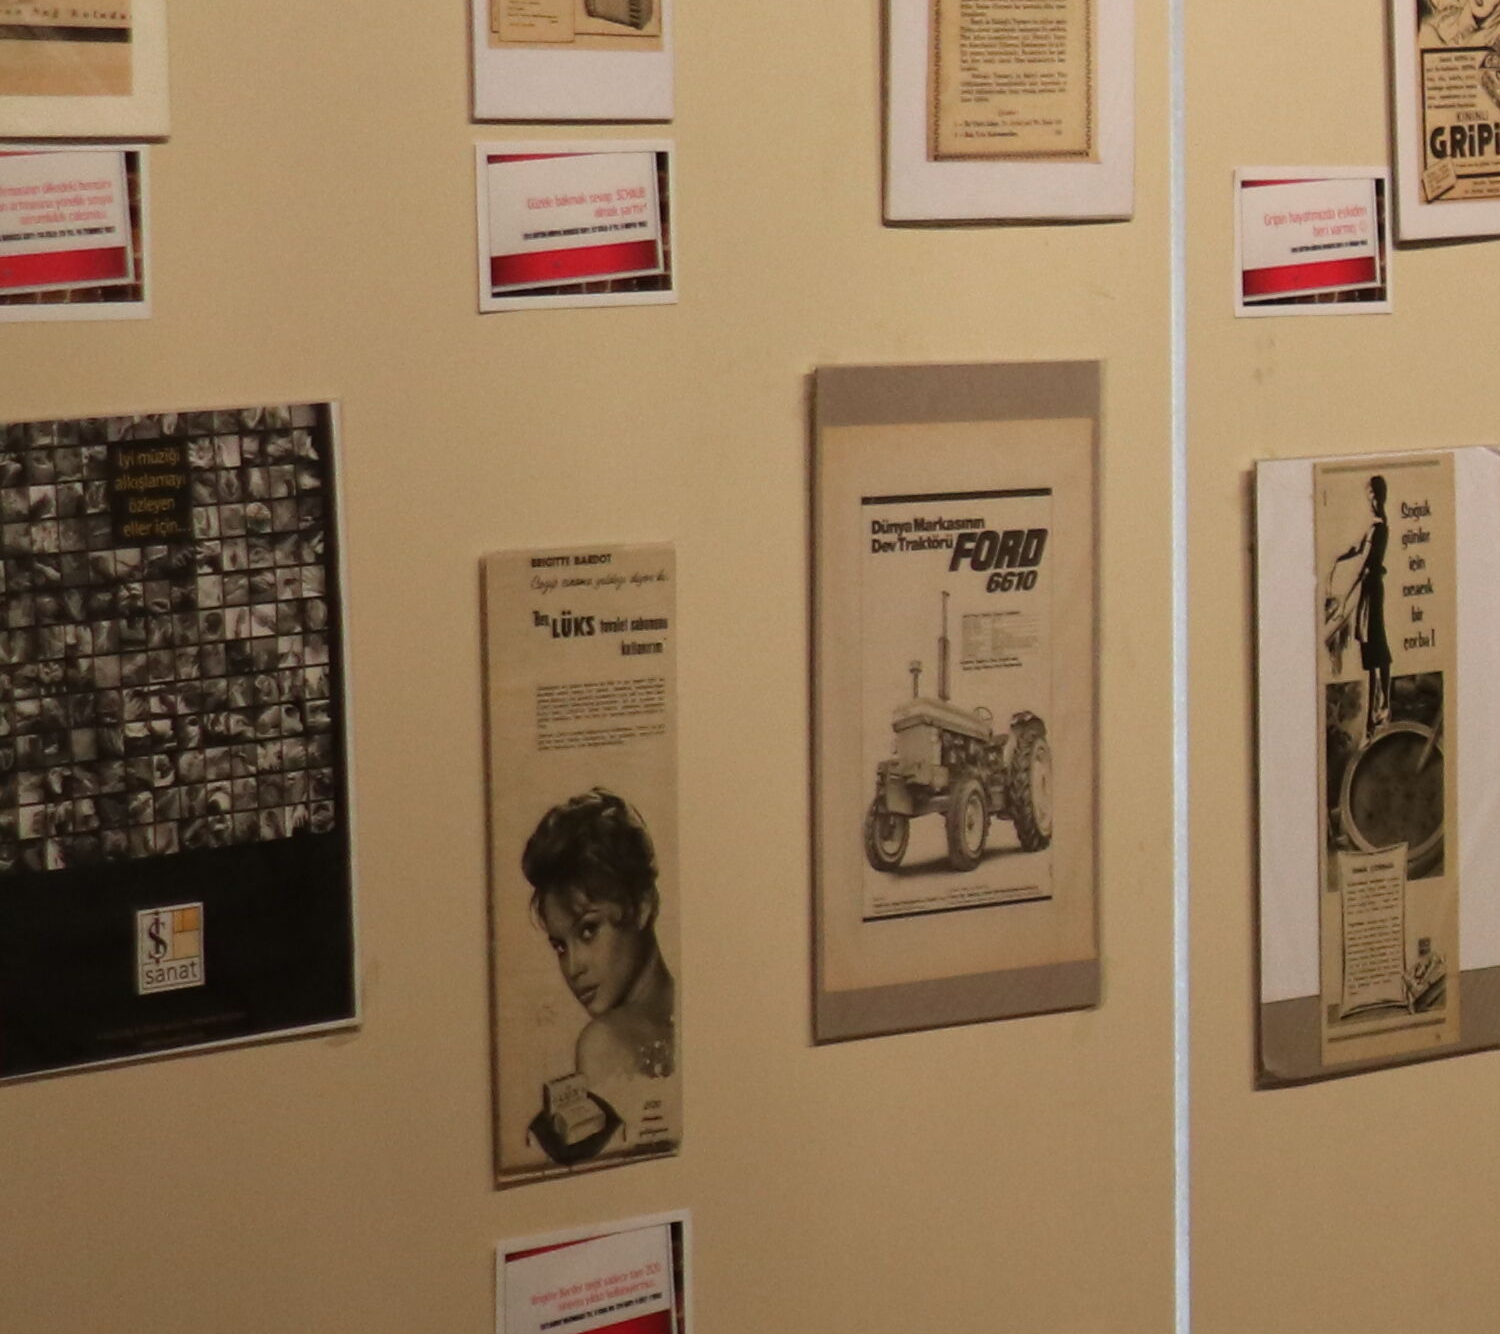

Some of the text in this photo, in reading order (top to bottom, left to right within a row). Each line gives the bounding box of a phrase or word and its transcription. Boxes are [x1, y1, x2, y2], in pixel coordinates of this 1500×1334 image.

[128, 496, 177, 515] özleyen
[1401, 500, 1433, 522] Soğuk
[123, 519, 153, 538] eller
[871, 517, 986, 536] Dünya Markasının
[871, 533, 953, 554] Dev Traktörü
[949, 528, 1048, 572] FORD
[986, 569, 1038, 594] 6610
[552, 610, 596, 639] LÜKS
[1411, 605, 1424, 623] bir
[145, 960, 198, 985] sanat
